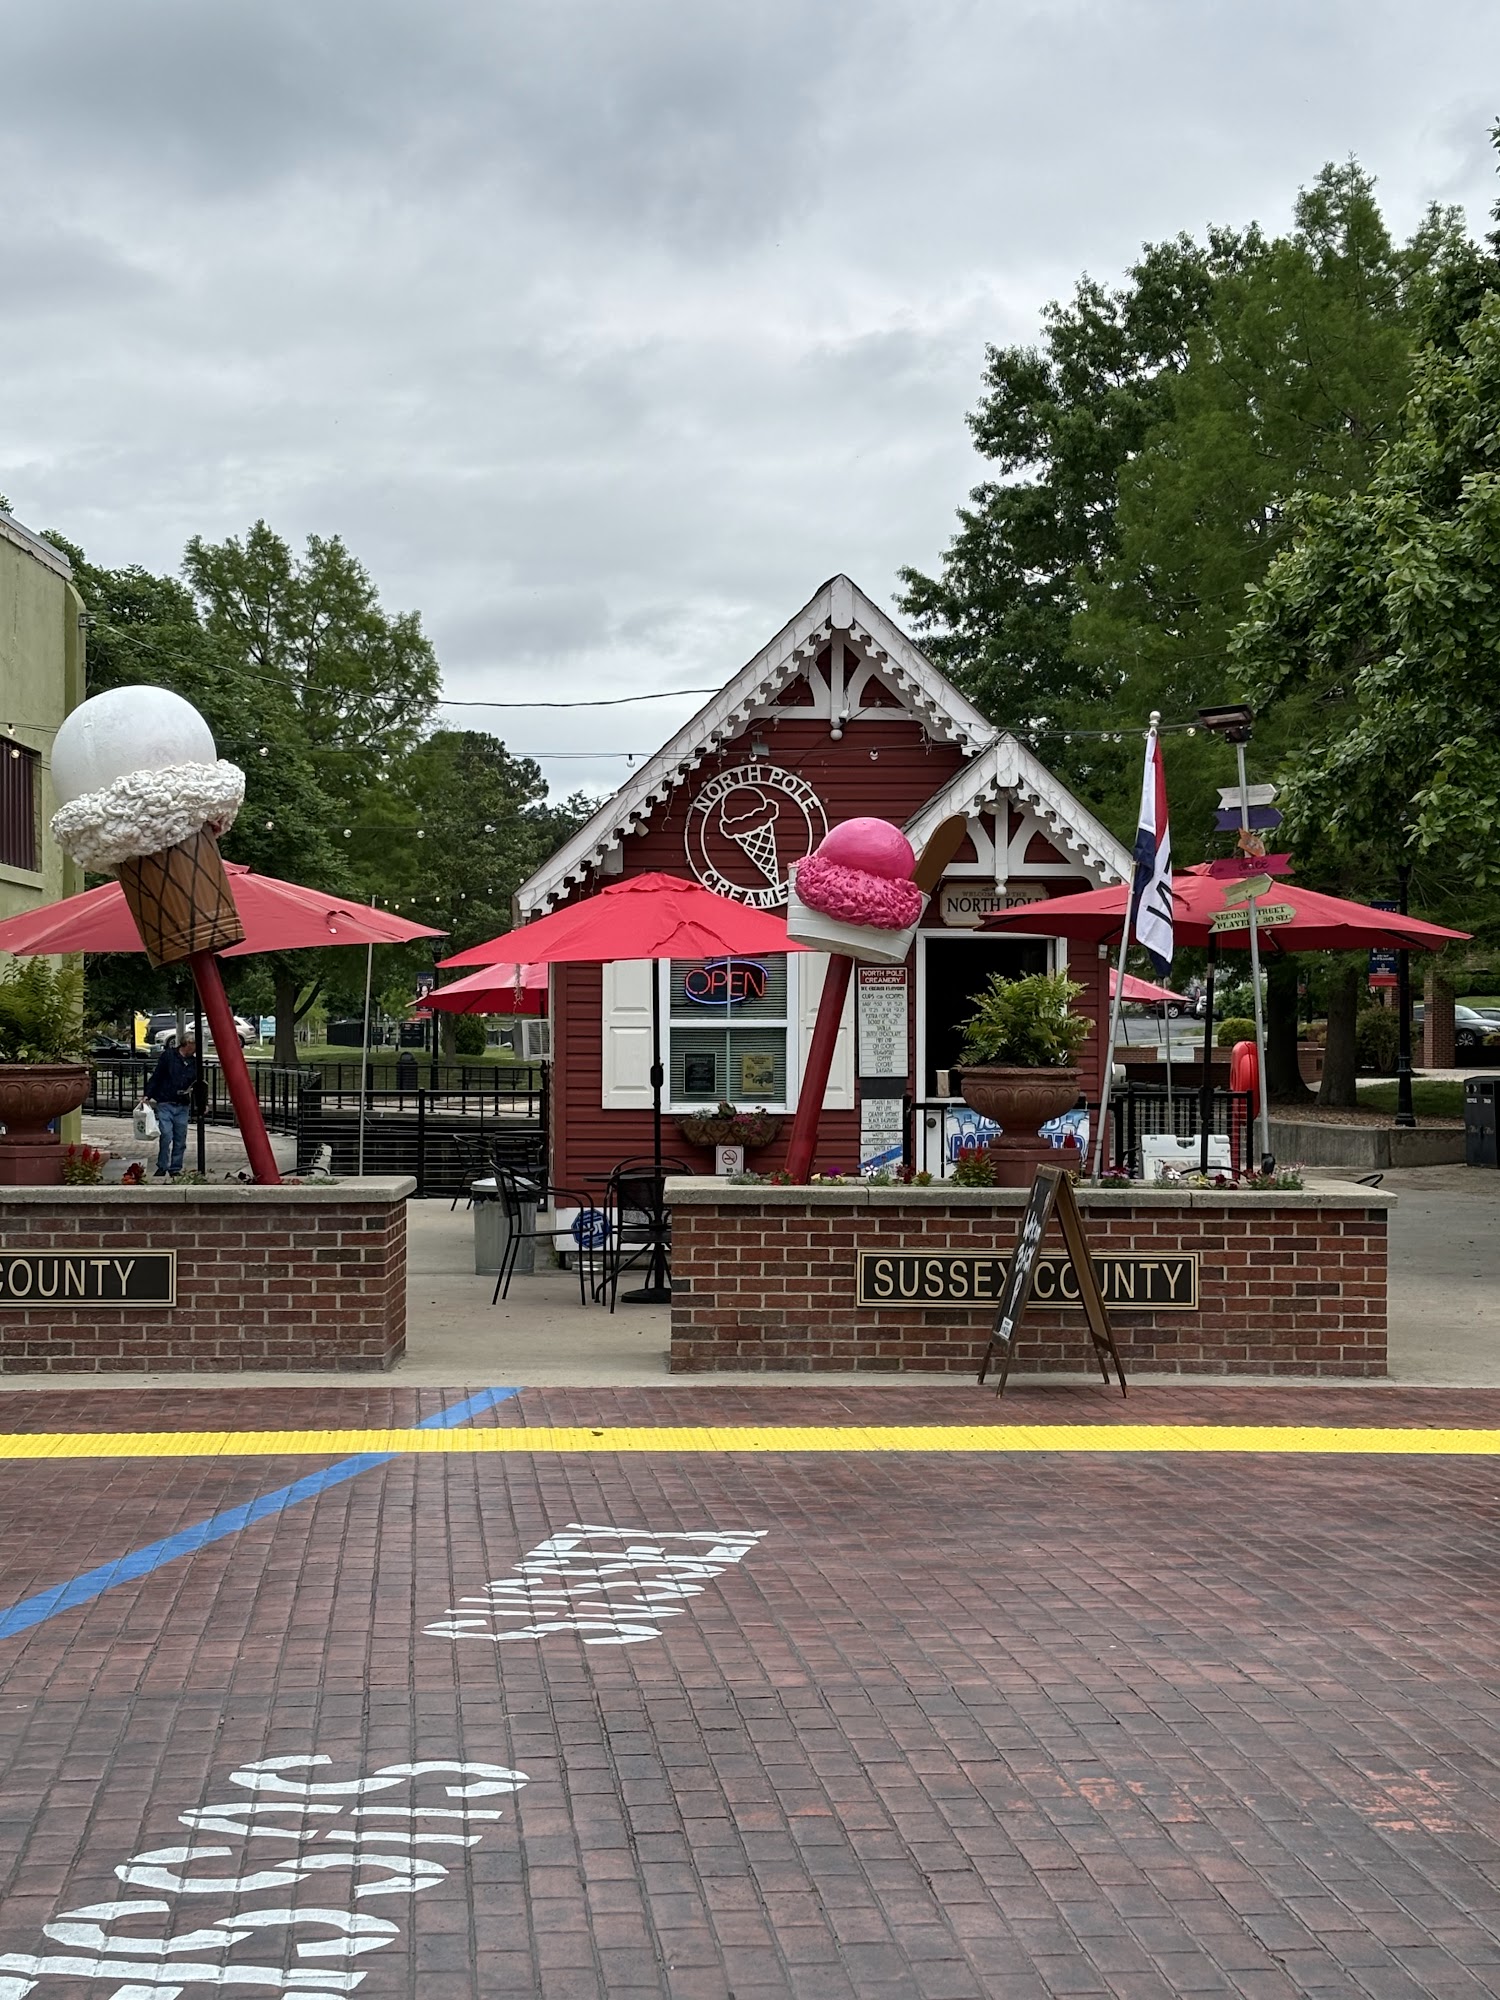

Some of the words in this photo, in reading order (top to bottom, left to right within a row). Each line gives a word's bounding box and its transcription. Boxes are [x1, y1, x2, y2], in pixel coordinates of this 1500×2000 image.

[694, 765, 761, 814] NORTH
[768, 768, 821, 814] POLE
[702, 869, 789, 907] CREAME
[947, 897, 1001, 912] NORTH
[1255, 906, 1286, 916] TREET
[686, 969, 765, 997] OPEN
